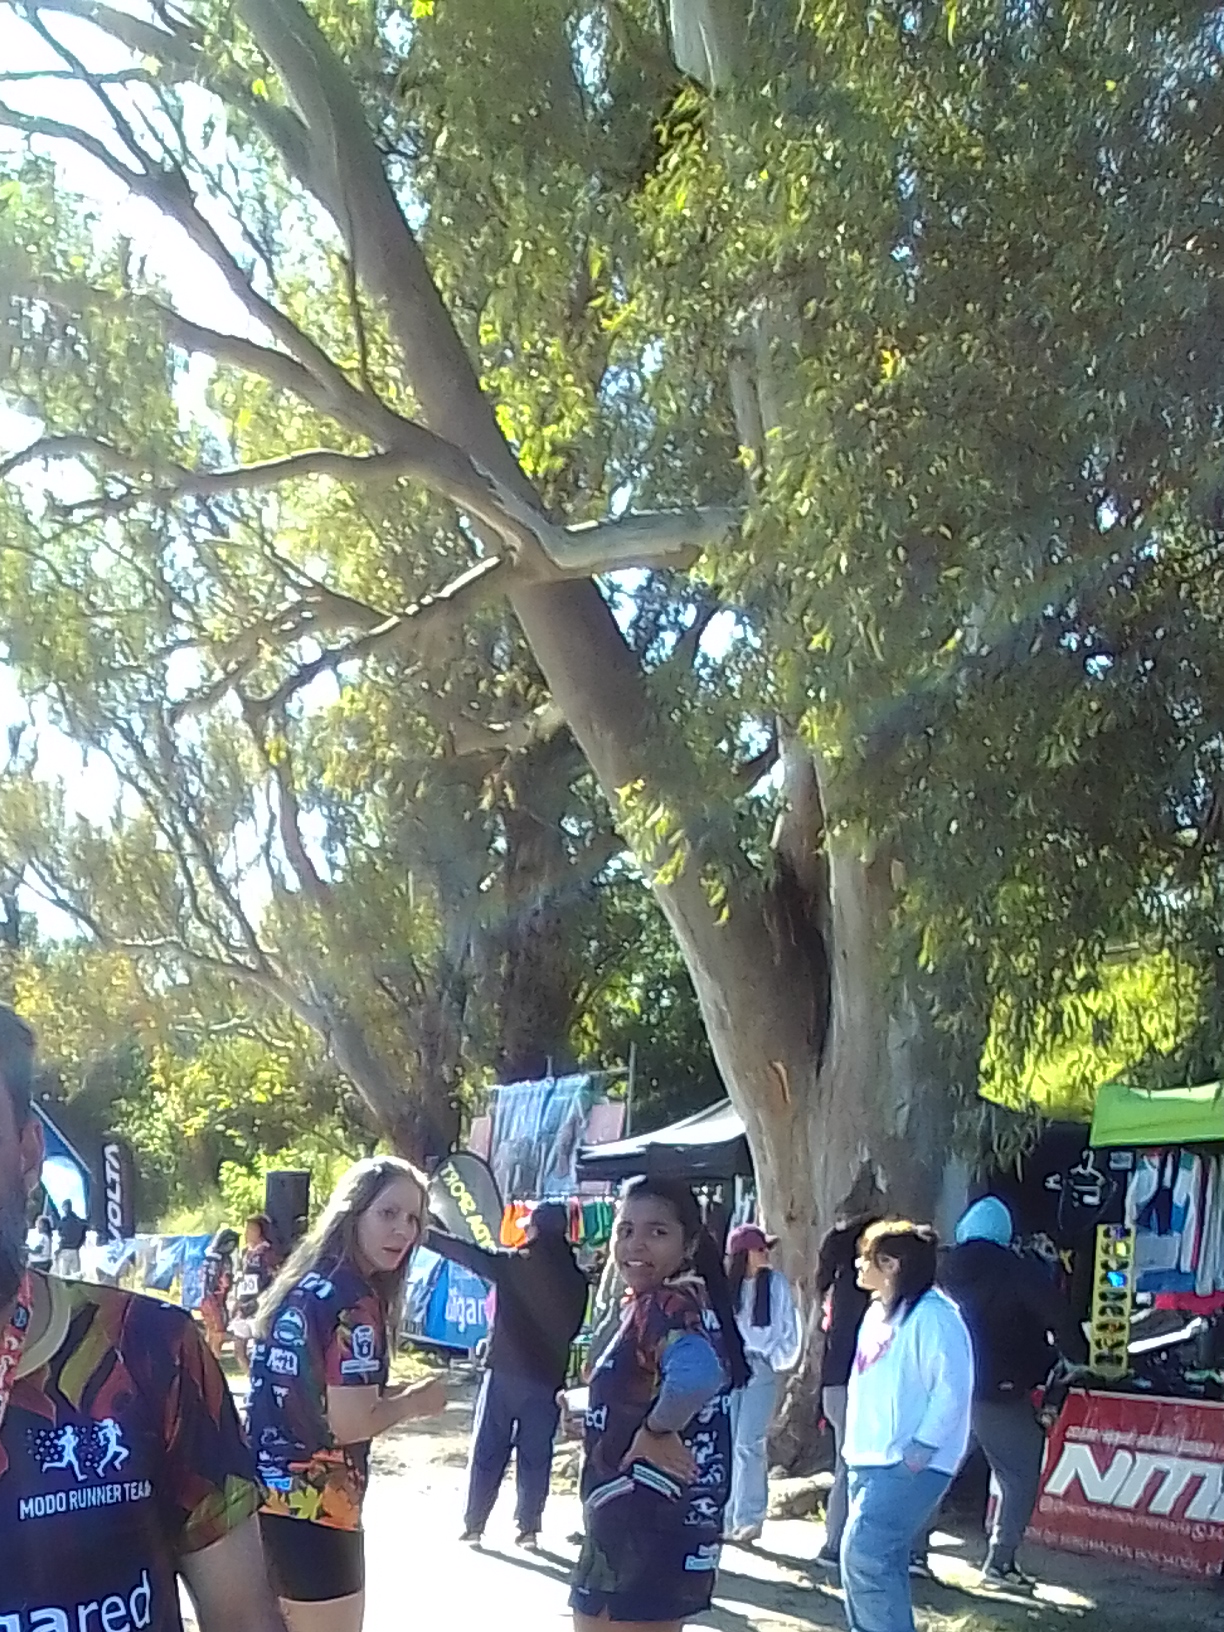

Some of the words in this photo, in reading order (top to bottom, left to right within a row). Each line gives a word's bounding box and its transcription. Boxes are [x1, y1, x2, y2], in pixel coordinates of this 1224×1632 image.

[104, 1143, 123, 1242] VOLTA
[445, 1287, 486, 1333] digar
[19, 1491, 66, 1520] MODO
[68, 1484, 121, 1511] RUNNER
[123, 1479, 153, 1501] TEAM
